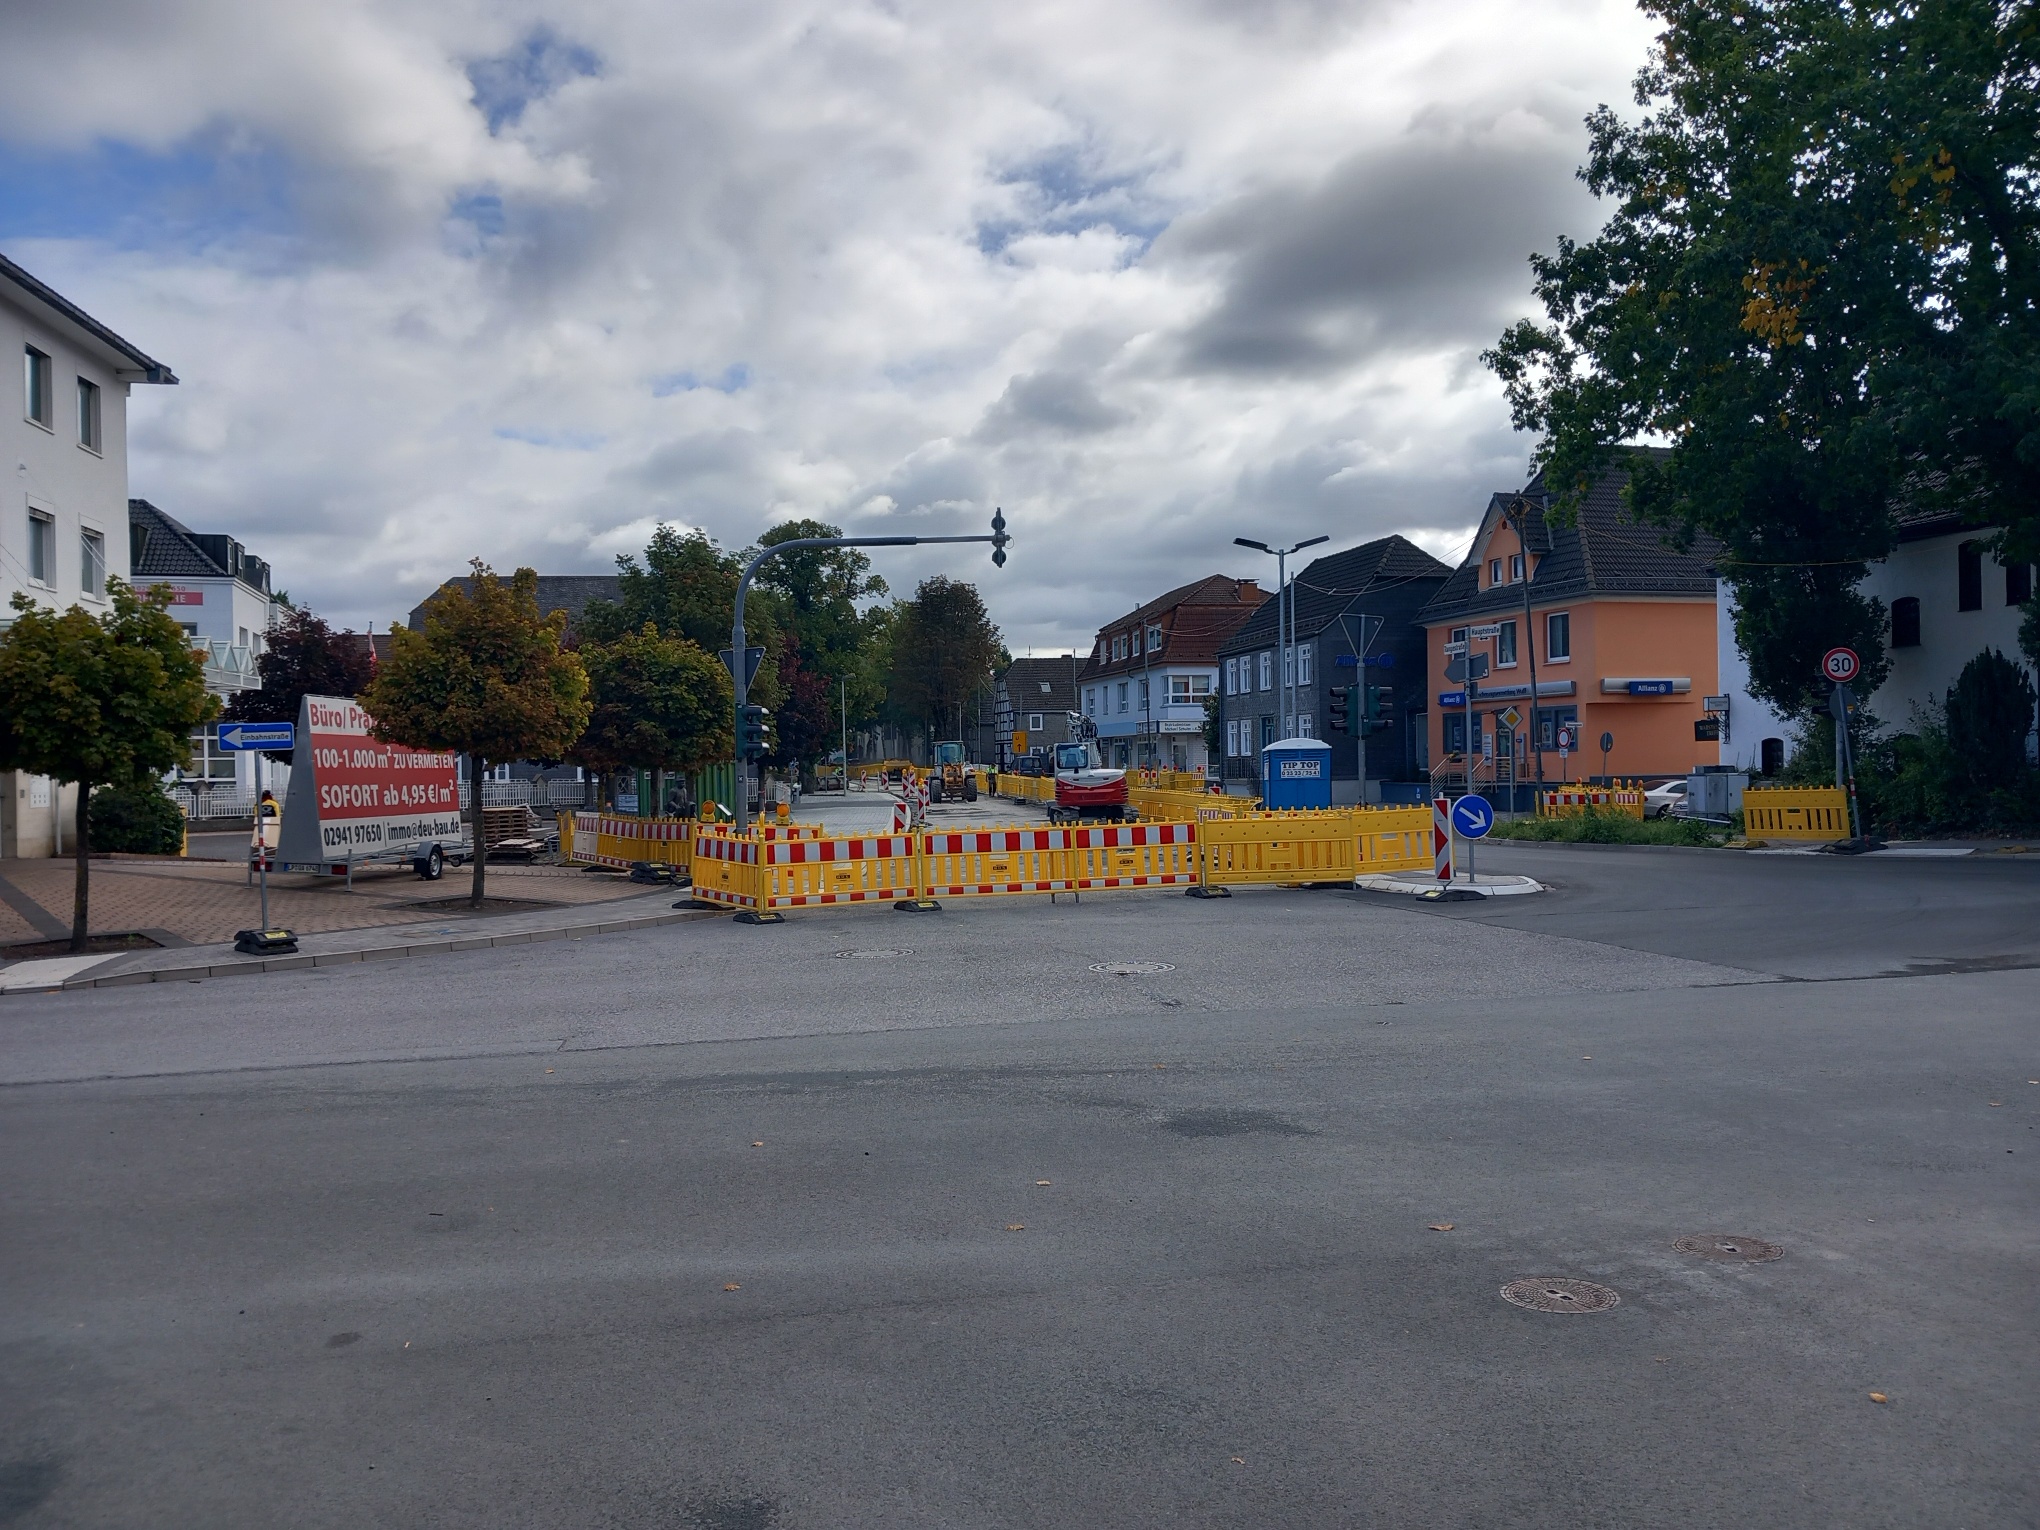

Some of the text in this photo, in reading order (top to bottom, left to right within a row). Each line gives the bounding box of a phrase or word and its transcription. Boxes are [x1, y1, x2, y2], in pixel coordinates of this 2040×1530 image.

[1472, 626, 1500, 636] Hauptstraße
[1830, 657, 1851, 673] 30
[310, 703, 346, 729] Büro/
[241, 733, 289, 741] Einbahnstraße
[314, 746, 454, 769] 100-1.000 m² ZU VERMIETEN
[1282, 761, 1319, 769] TIP TOP
[321, 784, 378, 809] SOFORT
[383, 783, 399, 806] ab
[401, 784, 426, 807] 4,95
[324, 816, 460, 847] 02941 97650 immo@deu-bau.de
